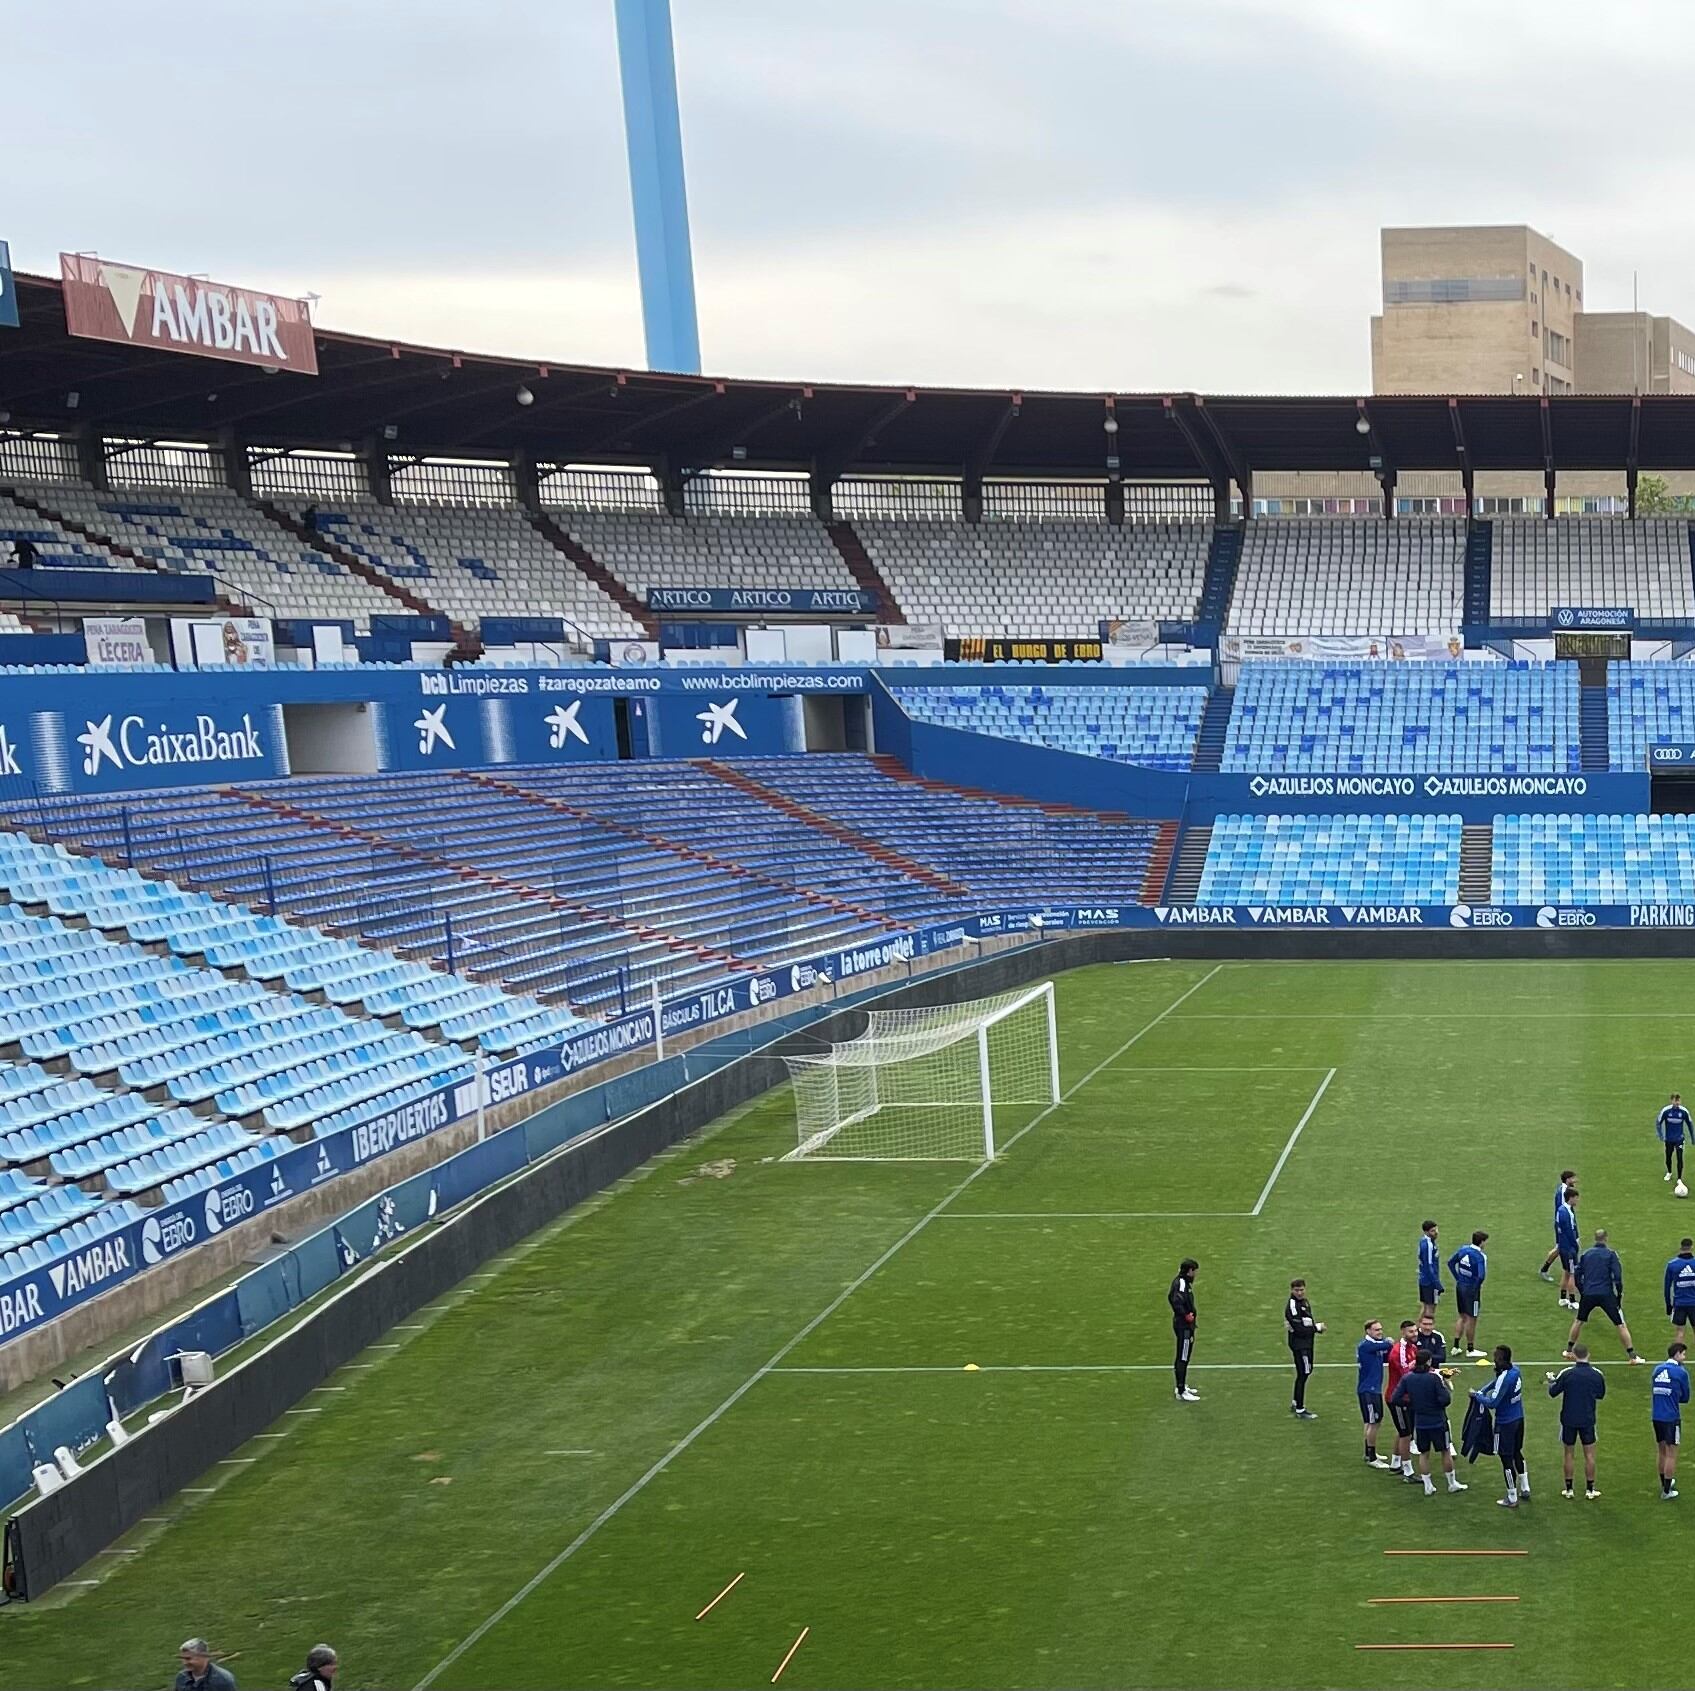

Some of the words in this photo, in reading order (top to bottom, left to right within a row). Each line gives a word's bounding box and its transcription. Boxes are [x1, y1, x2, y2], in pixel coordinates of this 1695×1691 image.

[152, 279, 288, 360] AMBAR
[731, 591, 791, 605] ARTICO
[1577, 608, 1628, 618] AUTOMOCIÓN
[1053, 643, 1067, 658] DE
[420, 673, 448, 695] bcb
[449, 674, 529, 696] Limpiezas
[538, 675, 661, 693] #zaragozateamo
[681, 673, 863, 691] www.bcblimpiezas.com
[120, 713, 264, 766] CaixaBank
[1269, 777, 1334, 794] AZULEJOS
[1336, 777, 1415, 794] MONCAYO
[1442, 777, 1508, 794] AZULEJOS
[1509, 777, 1587, 794] MONCAYO
[979, 915, 1001, 928] MAS
[1078, 909, 1119, 919] MAS
[1168, 907, 1236, 923] AMBAR
[1263, 907, 1330, 923] AMBAR
[1356, 907, 1423, 923] AMBAR
[1473, 912, 1513, 925] EBRO
[1558, 912, 1596, 925] EBRO
[1631, 905, 1694, 926] PARKING
[840, 952, 853, 976] la
[853, 947, 881, 972] torre
[662, 1004, 699, 1030] BÁSCULAS
[700, 988, 736, 1021] TILCA
[573, 1030, 609, 1067] AZULEJOS
[608, 1015, 652, 1054] MONCAYO
[491, 1062, 528, 1103] SEUR
[352, 1092, 449, 1162] IBERPUERTAS
[222, 1189, 254, 1223] EBRO
[161, 1217, 195, 1253] EBRO
[68, 1236, 130, 1297] AMBAR
[0, 1283, 44, 1332] BAR
